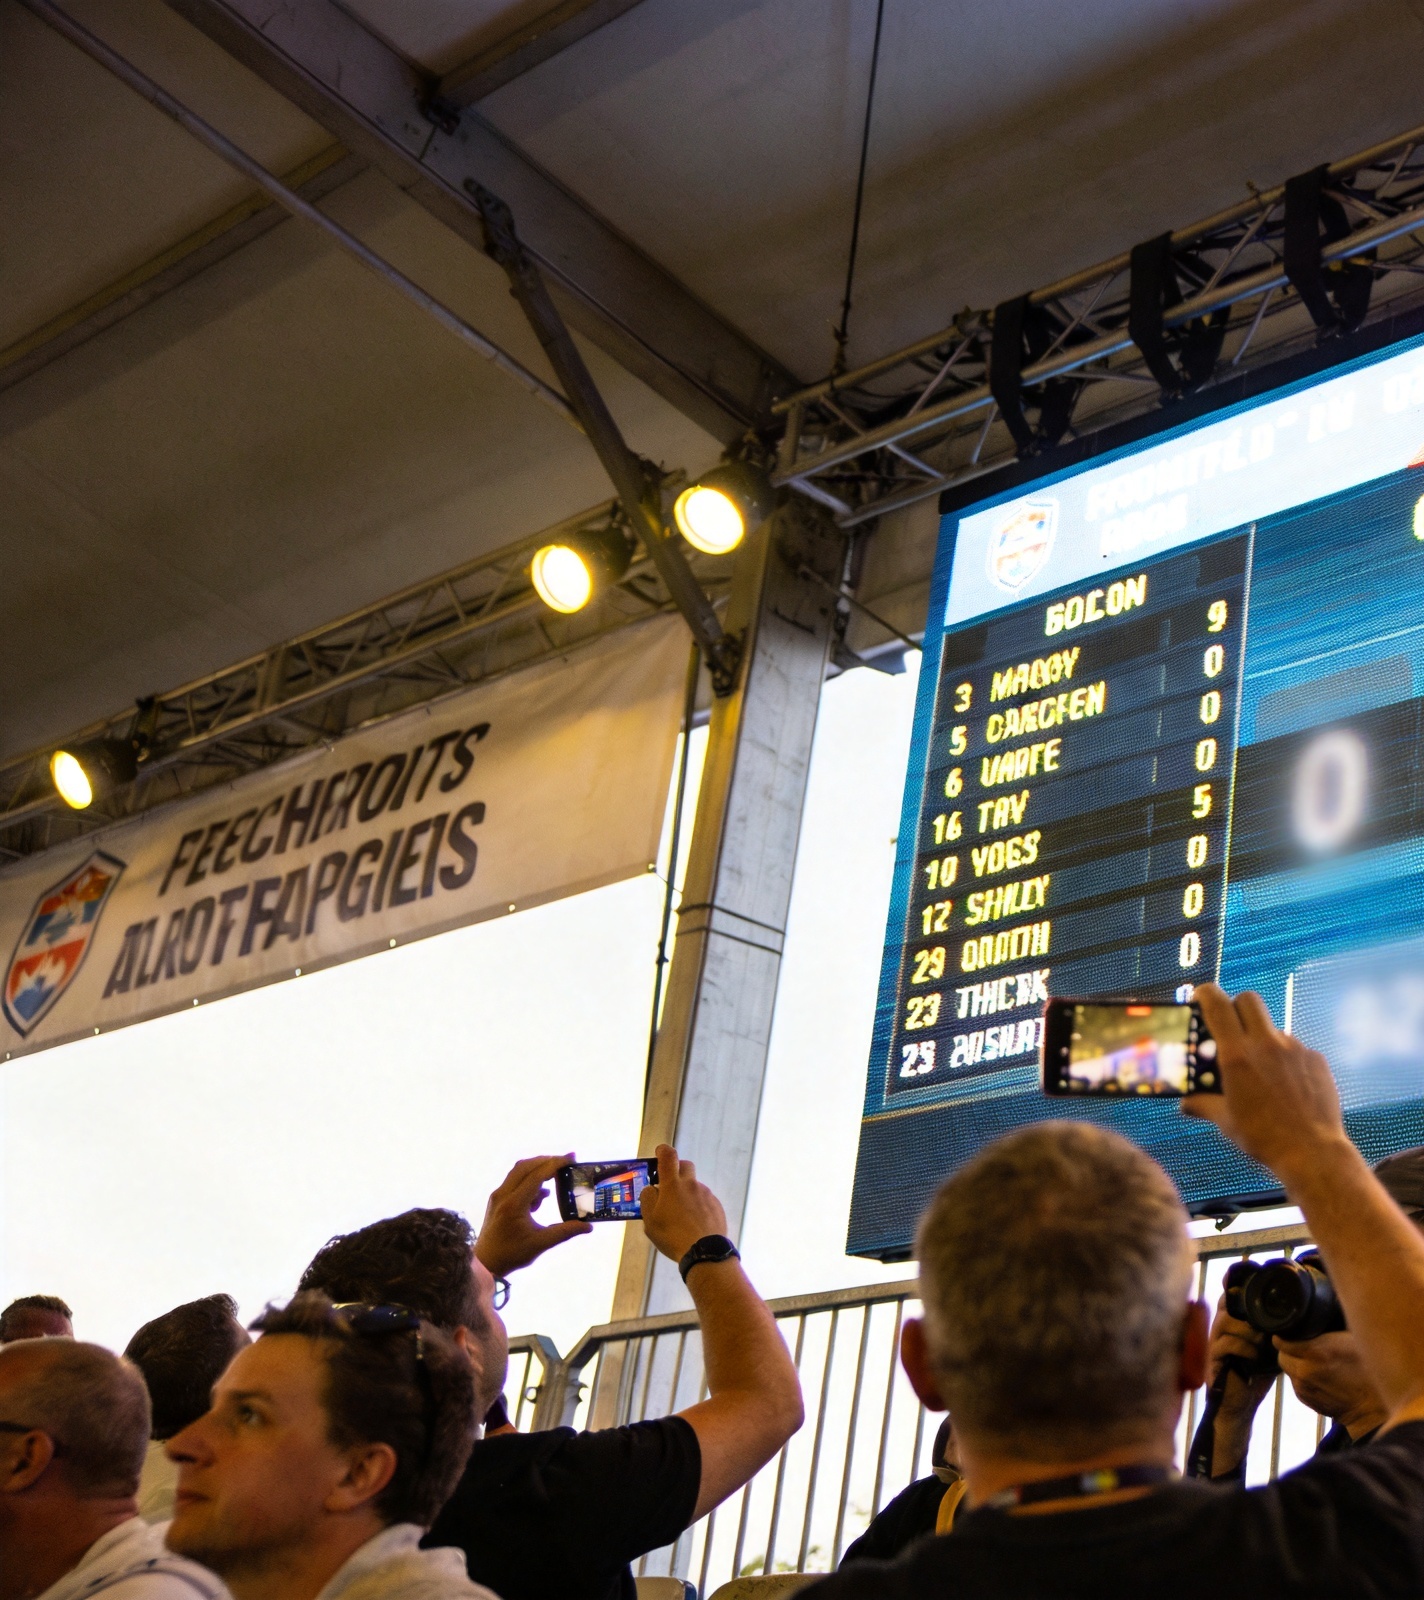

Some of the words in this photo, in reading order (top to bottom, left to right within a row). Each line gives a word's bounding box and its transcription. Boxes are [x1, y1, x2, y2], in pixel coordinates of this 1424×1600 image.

[949, 725, 967, 756] 5
[1203, 644, 1224, 677] 0
[954, 683, 972, 712] 3
[1207, 600, 1227, 632] 9
[932, 811, 962, 845] 16
[1195, 738, 1217, 772] 0
[944, 768, 963, 798] 6
[1200, 690, 1221, 724] 0
[922, 900, 953, 936] 12
[1186, 833, 1208, 868] 0
[926, 855, 959, 890] 10
[1192, 784, 1212, 819] 5
[905, 992, 942, 1031] 23
[1178, 932, 1201, 969] 0
[911, 946, 946, 984] 29
[1182, 882, 1204, 919] 0
